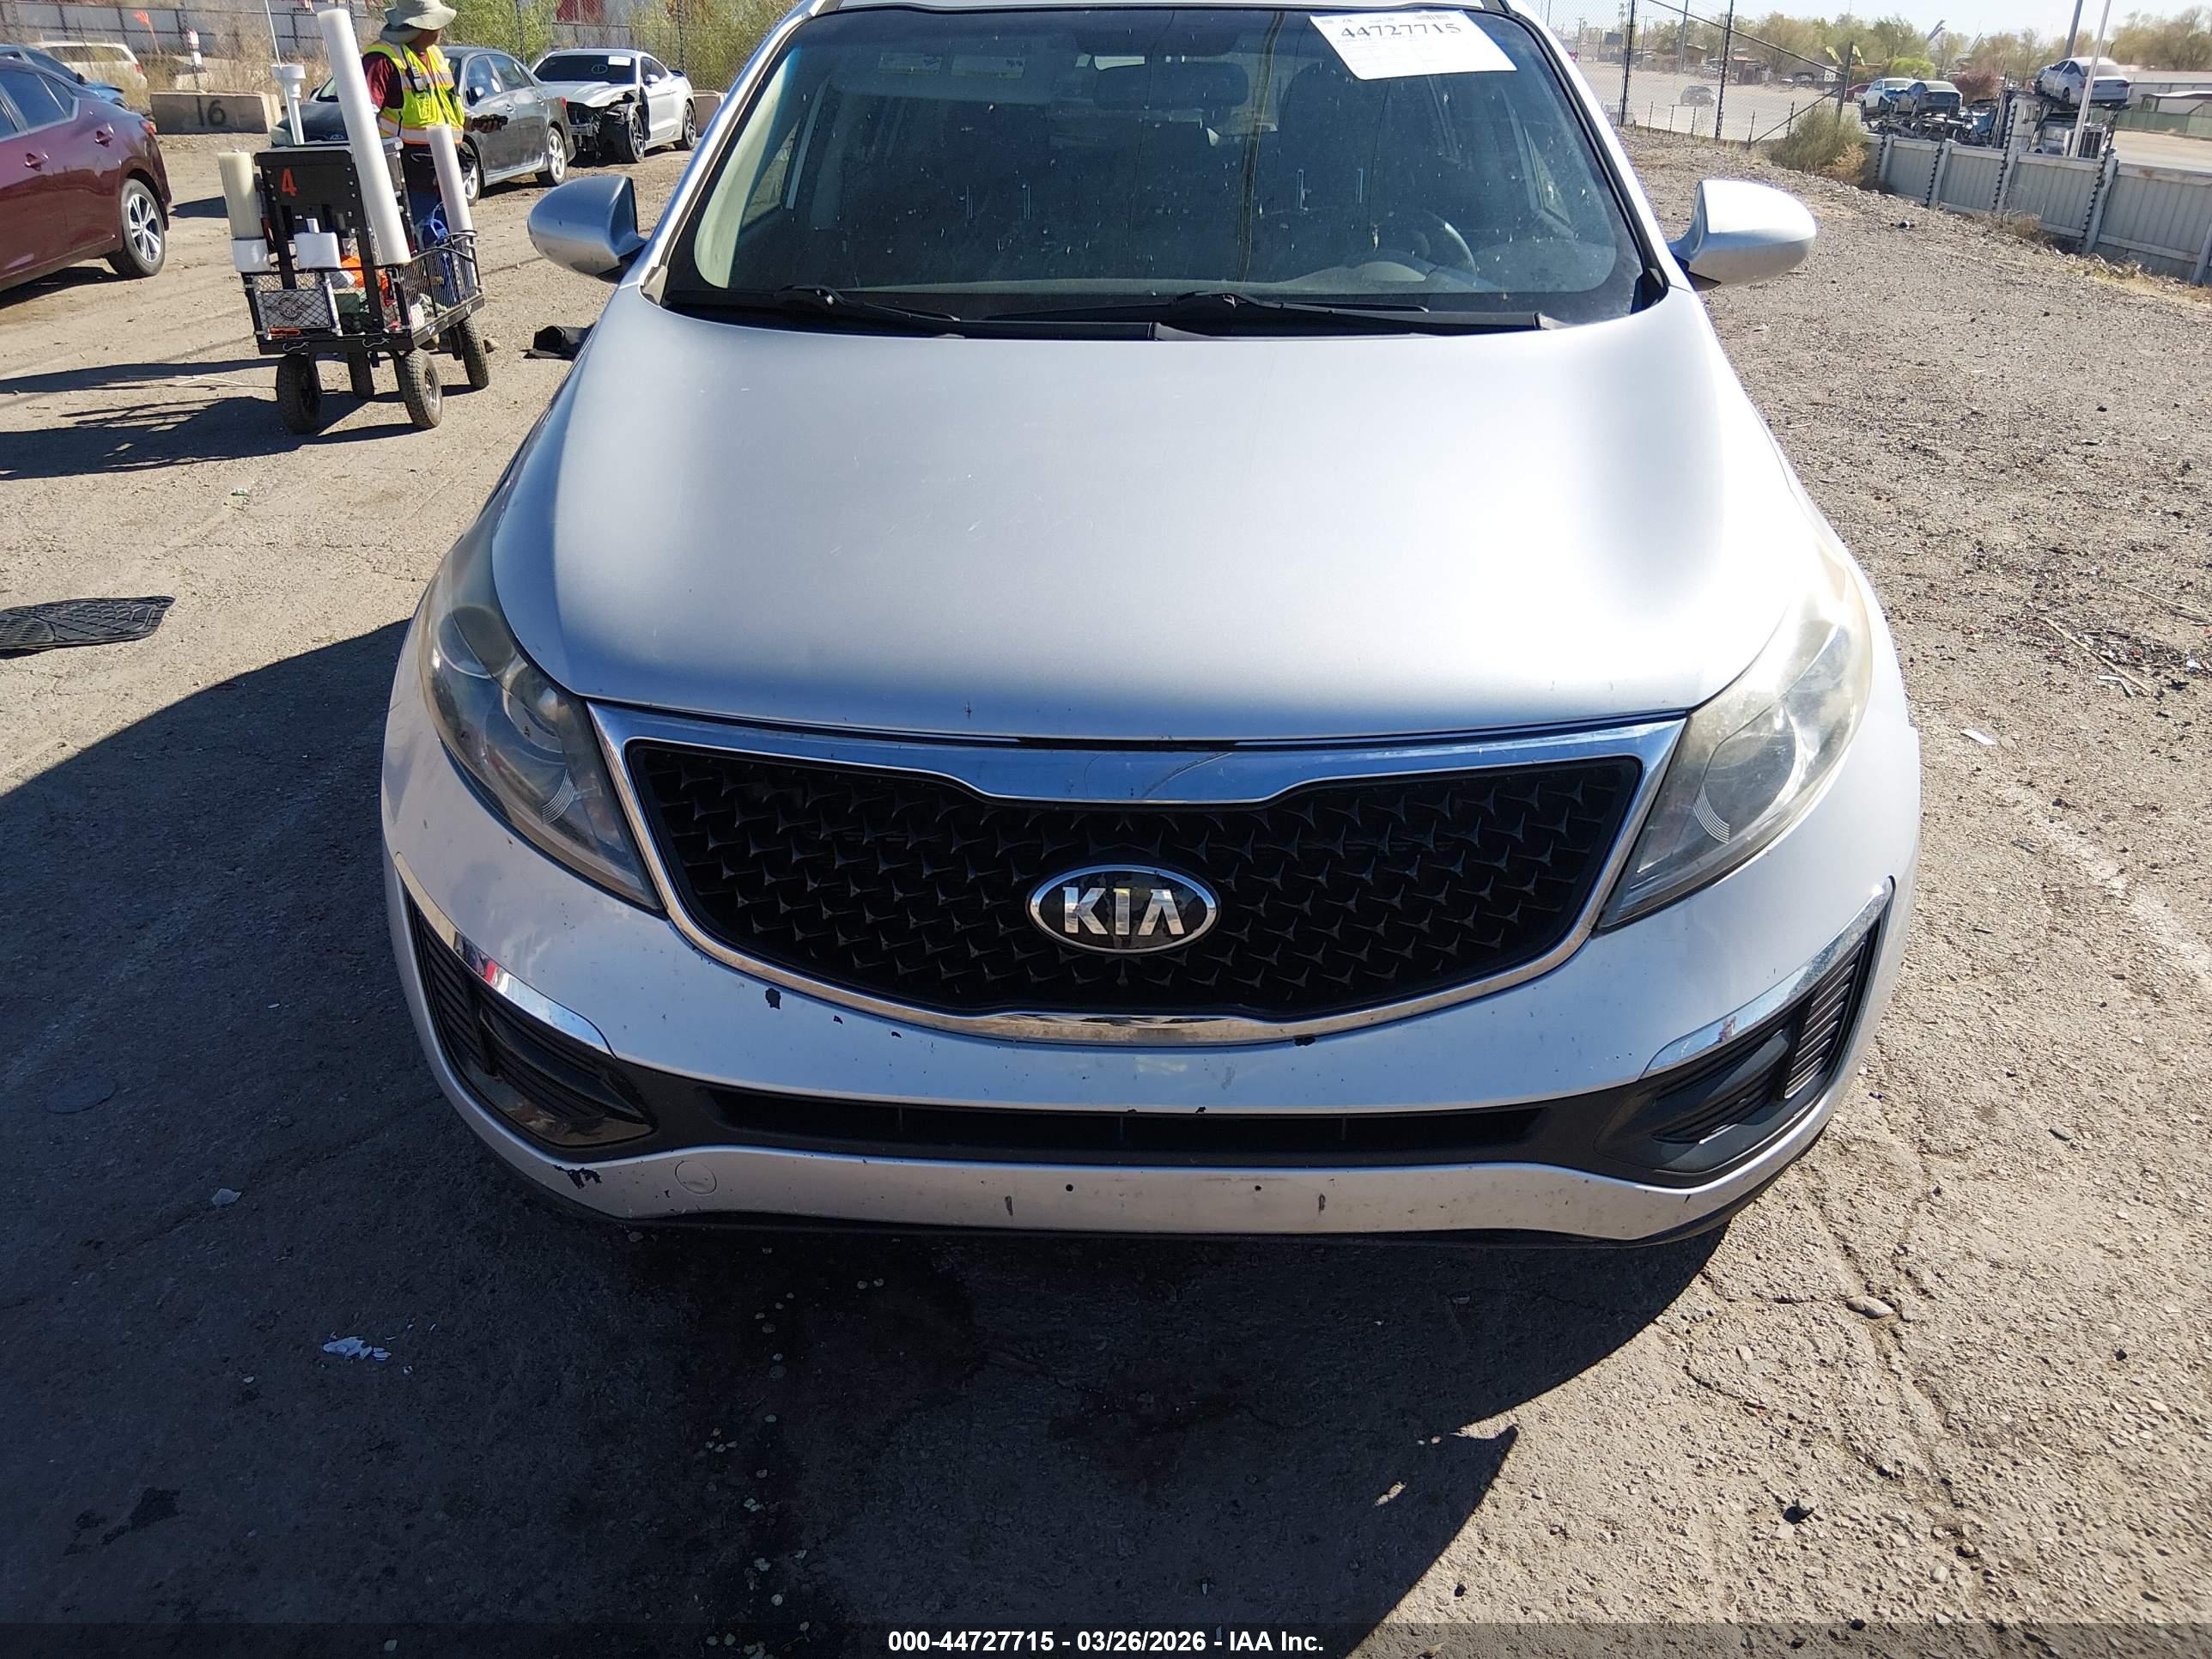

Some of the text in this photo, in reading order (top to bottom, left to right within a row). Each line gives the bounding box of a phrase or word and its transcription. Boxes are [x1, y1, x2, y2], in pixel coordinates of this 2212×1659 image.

[1340, 23, 1462, 38] 44727715
[197, 96, 226, 127] 16
[282, 168, 298, 197] 4
[1062, 885, 1185, 936] KIA
